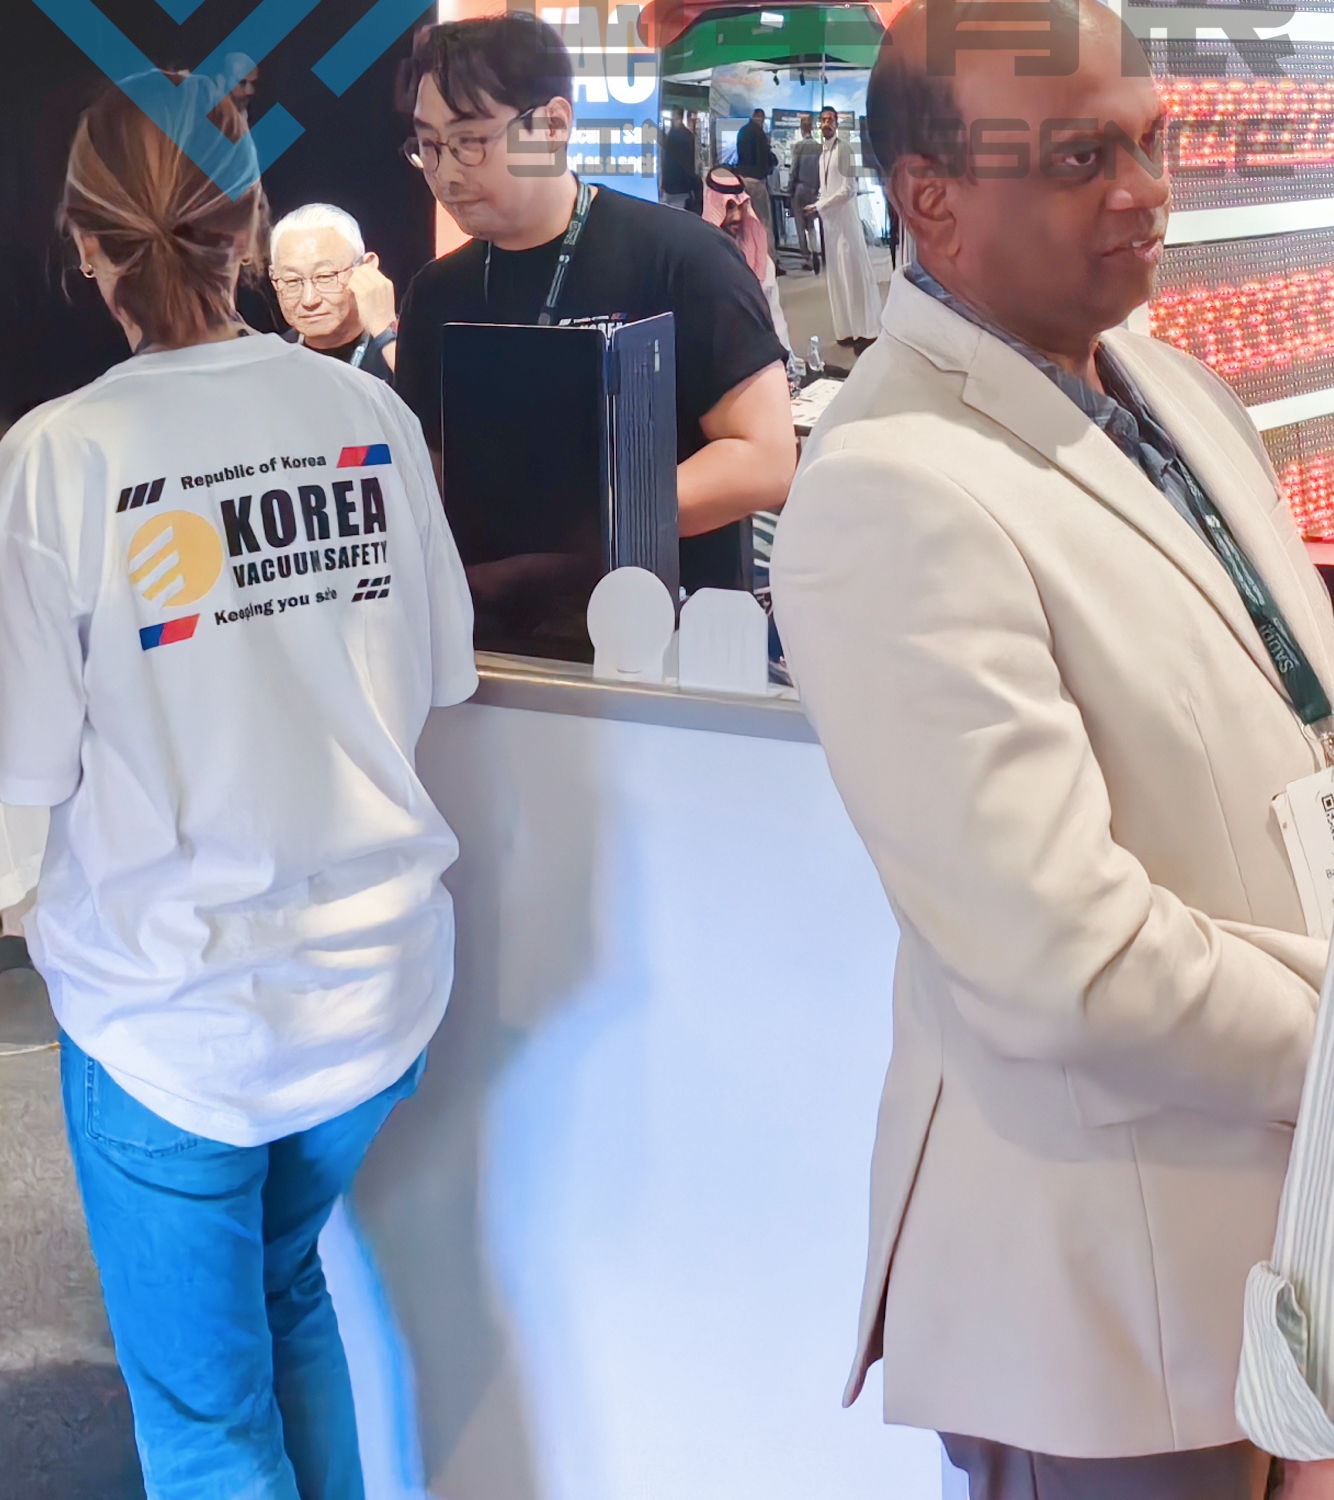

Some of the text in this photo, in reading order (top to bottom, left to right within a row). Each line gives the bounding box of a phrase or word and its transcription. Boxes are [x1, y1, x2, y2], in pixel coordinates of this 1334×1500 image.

[181, 455, 327, 490] Republic of Korea
[220, 476, 388, 558] KOREA
[324, 540, 388, 571] SAFETY
[278, 593, 310, 613] you
